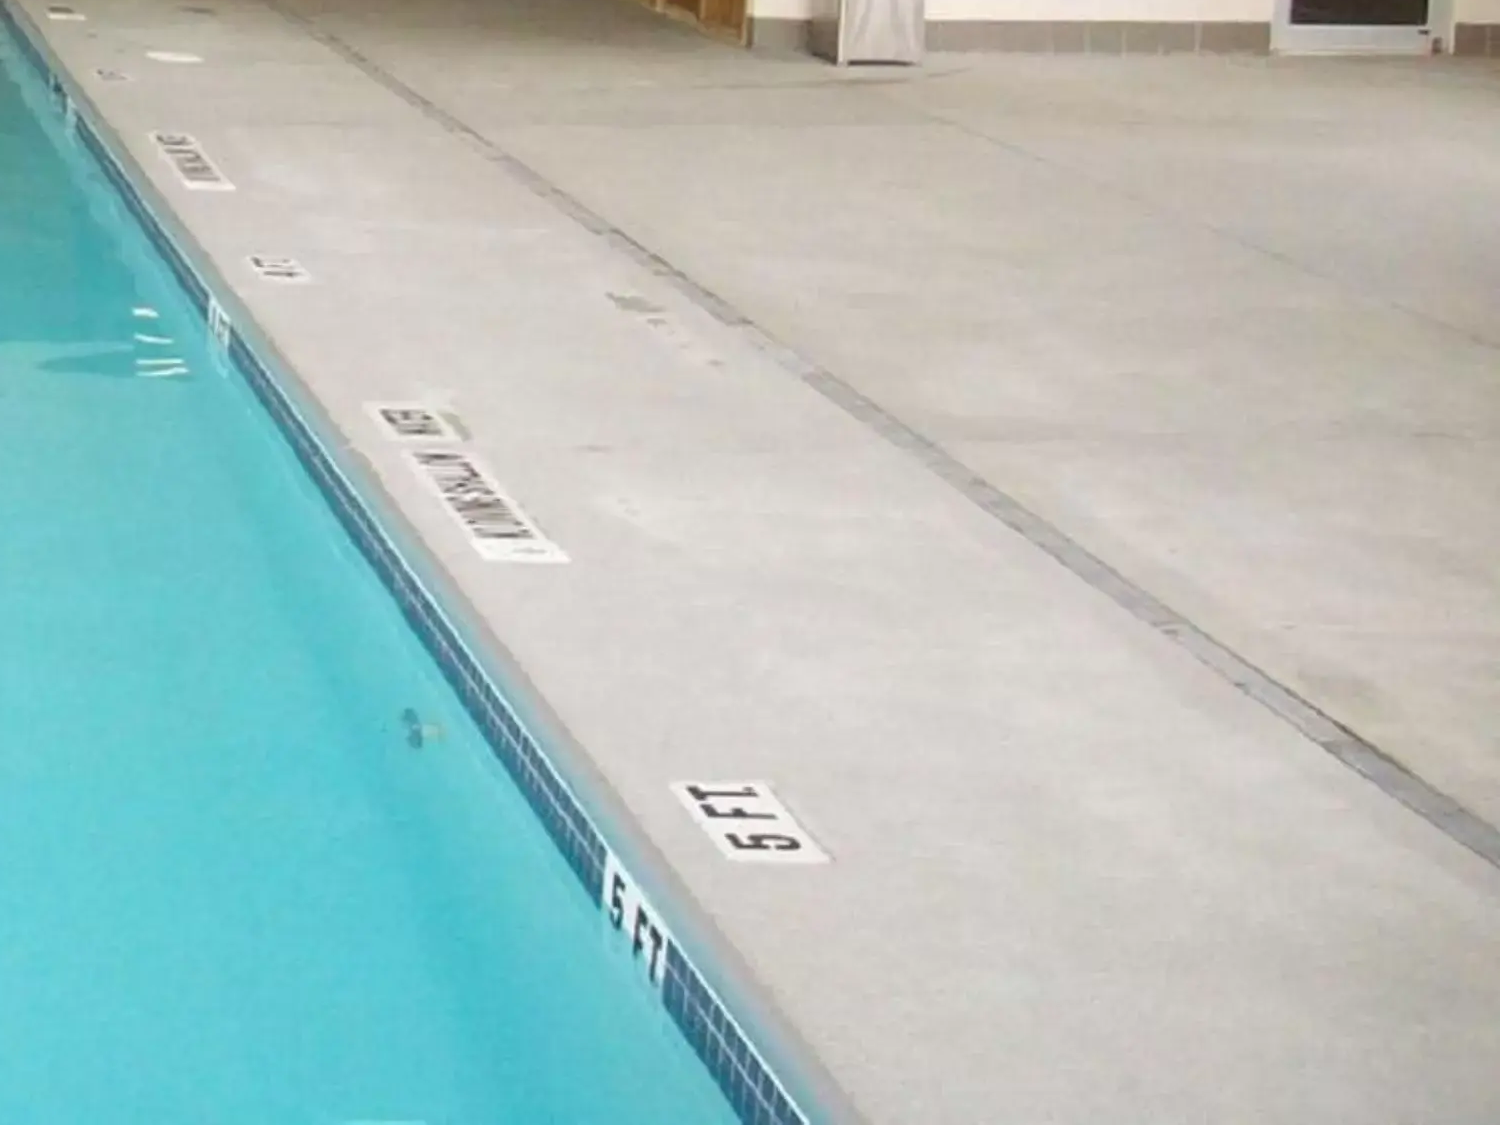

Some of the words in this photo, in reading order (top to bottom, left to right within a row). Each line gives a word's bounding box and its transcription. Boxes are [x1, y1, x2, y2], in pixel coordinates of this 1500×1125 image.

[685, 785, 780, 821] FT
[725, 832, 802, 851] 5
[609, 872, 626, 931] 5
[632, 904, 663, 982] FT
